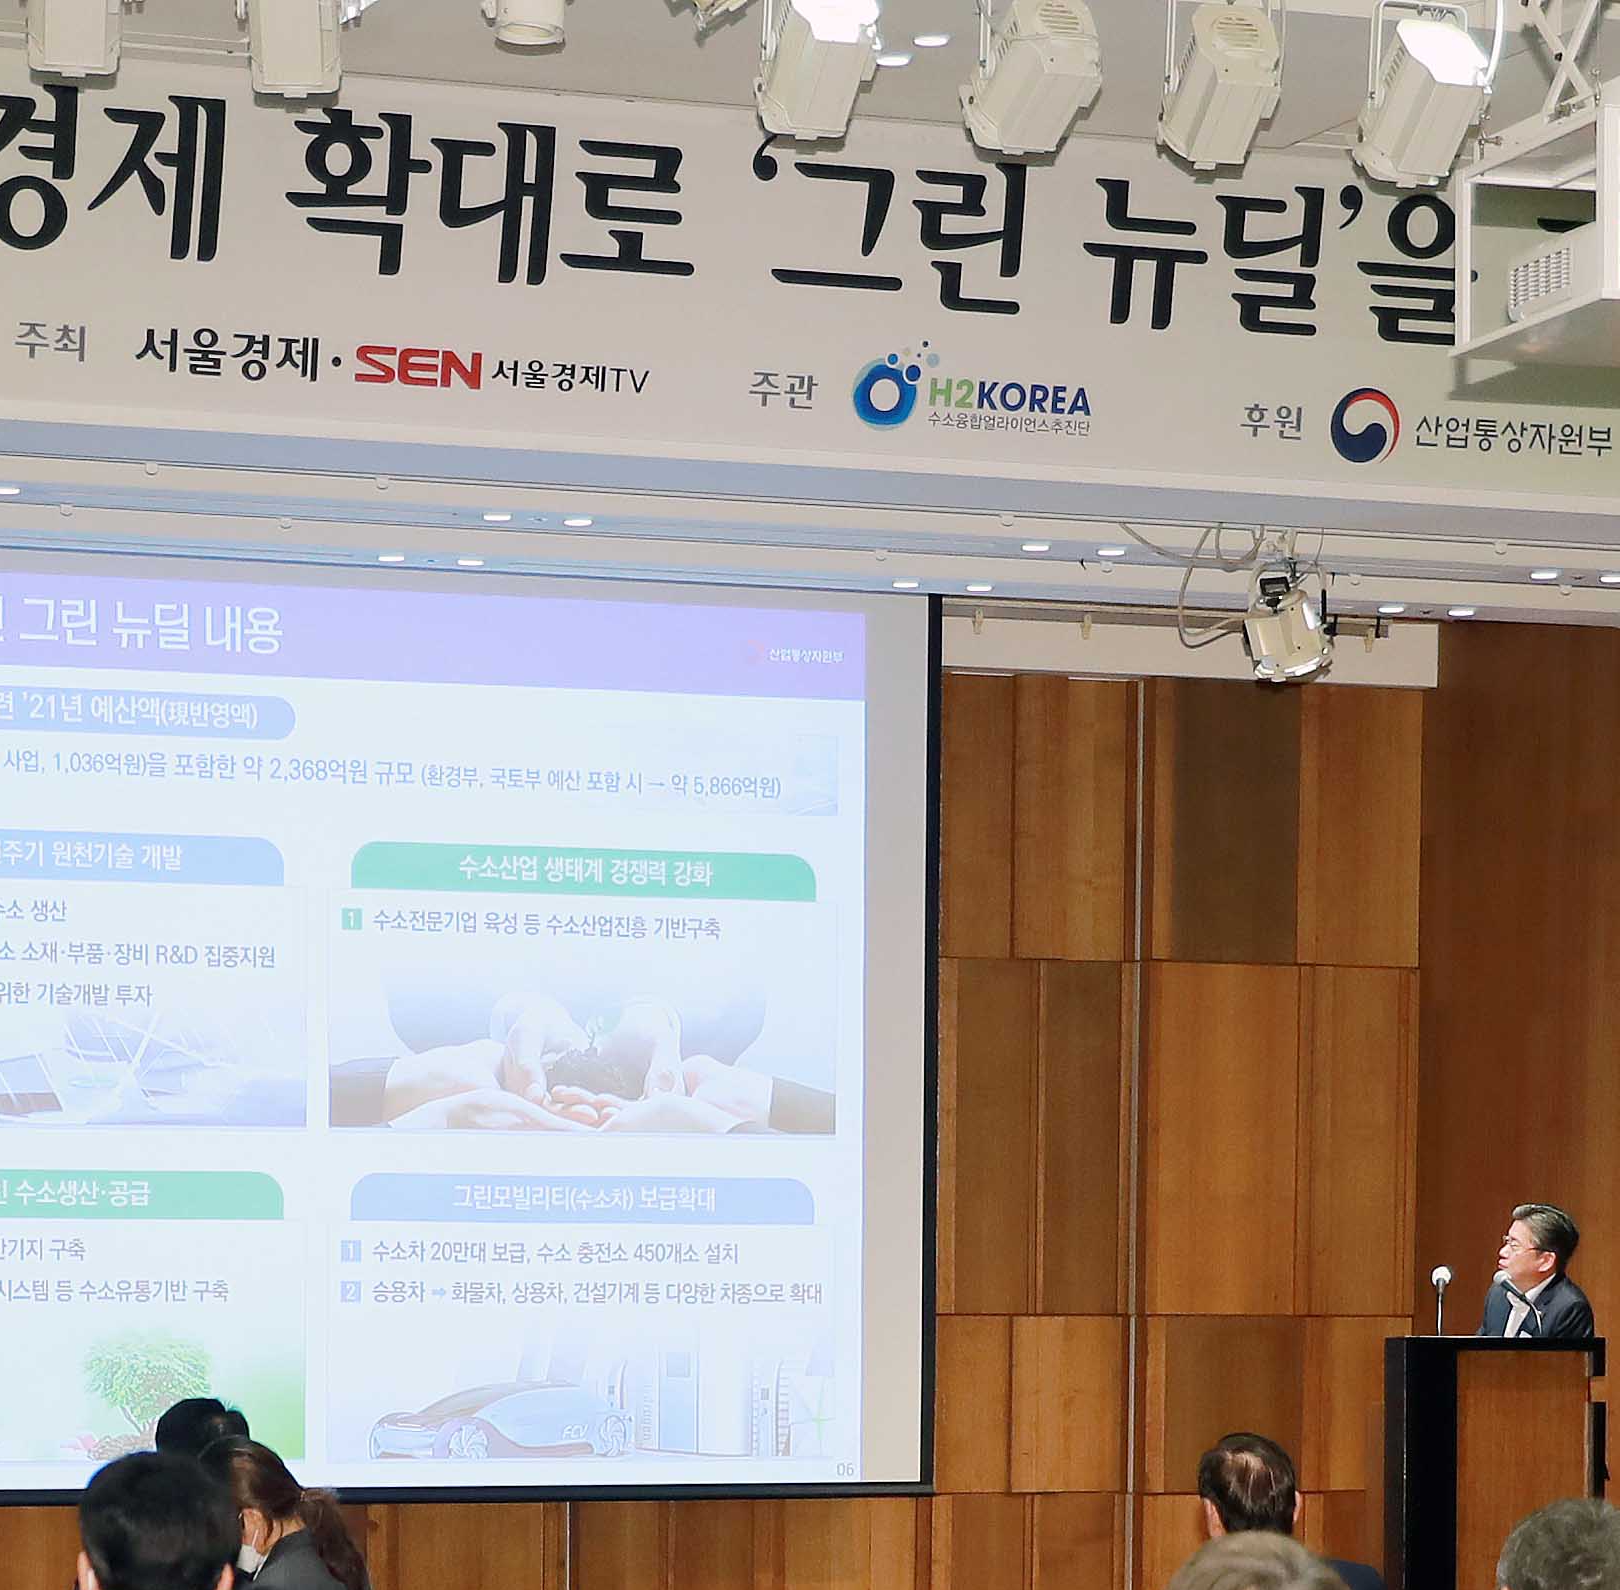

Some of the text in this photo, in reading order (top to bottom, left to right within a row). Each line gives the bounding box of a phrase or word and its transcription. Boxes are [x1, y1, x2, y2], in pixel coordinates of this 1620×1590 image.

[285, 104, 695, 286] 확대로
[15, 321, 86, 362] 주최
[354, 344, 482, 390] SEN
[491, 358, 650, 396] 서울경제TV
[748, 370, 1092, 417] 주관 H2KOREA
[928, 412, 1091, 437] 수소융합얼라이언스추진단
[1240, 403, 1613, 457] 후원 산업통상자원부
[19, 596, 98, 647] 그린
[113, 602, 191, 652] 뉴딜
[204, 605, 284, 655] 내용
[4, 749, 45, 774] 사업,
[53, 751, 168, 778] 1,036억원)을
[174, 754, 237, 780] 포함한
[243, 755, 263, 782] 약
[269, 757, 368, 785] 2,368억원
[375, 760, 415, 785] 규모
[420, 763, 483, 789] (환경부,
[490, 766, 541, 790] 국토부
[547, 768, 581, 792] 예산
[587, 770, 621, 793] 포함
[626, 771, 642, 794] 시
[671, 773, 688, 797] 약
[693, 776, 782, 799] 5,866억원)
[51, 840, 134, 869] 원천기술
[141, 843, 183, 872] 개발
[459, 855, 713, 888] 수소산업 생태계 경쟁력 강화
[30, 899, 67, 922] 생산
[373, 909, 477, 933] 수소전문기업
[483, 912, 518, 935] 육성
[523, 913, 541, 936] 등
[546, 914, 648, 940] 수소산업진흥
[653, 916, 721, 941] 기반구축
[155, 945, 198, 965] R&D
[204, 945, 276, 969] 집중지원
[36, 982, 110, 1006] 기술개발
[115, 984, 154, 1007] 투자
[640, 1187, 716, 1211] 보급확대
[49, 1238, 86, 1261] 구축
[372, 1240, 426, 1262] 수소차
[431, 1241, 486, 1263] 20만대
[492, 1242, 530, 1264] 보급,
[537, 1242, 573, 1263] 수소
[577, 1242, 628, 1264] 충전소
[634, 1242, 700, 1264] 450개소
[704, 1242, 739, 1265] 설치
[55, 1279, 74, 1302] 등
[79, 1279, 188, 1302] 수소유통기반
[193, 1279, 229, 1302] 구축
[372, 1280, 425, 1303] 승용차
[452, 1281, 506, 1305] 화물차,
[512, 1282, 568, 1305] 상용차,
[573, 1281, 640, 1304] 건설기계
[644, 1282, 661, 1304] 등
[665, 1282, 716, 1305] 다양한
[720, 1282, 786, 1305] 차종으로
[789, 1282, 822, 1305] 확대
